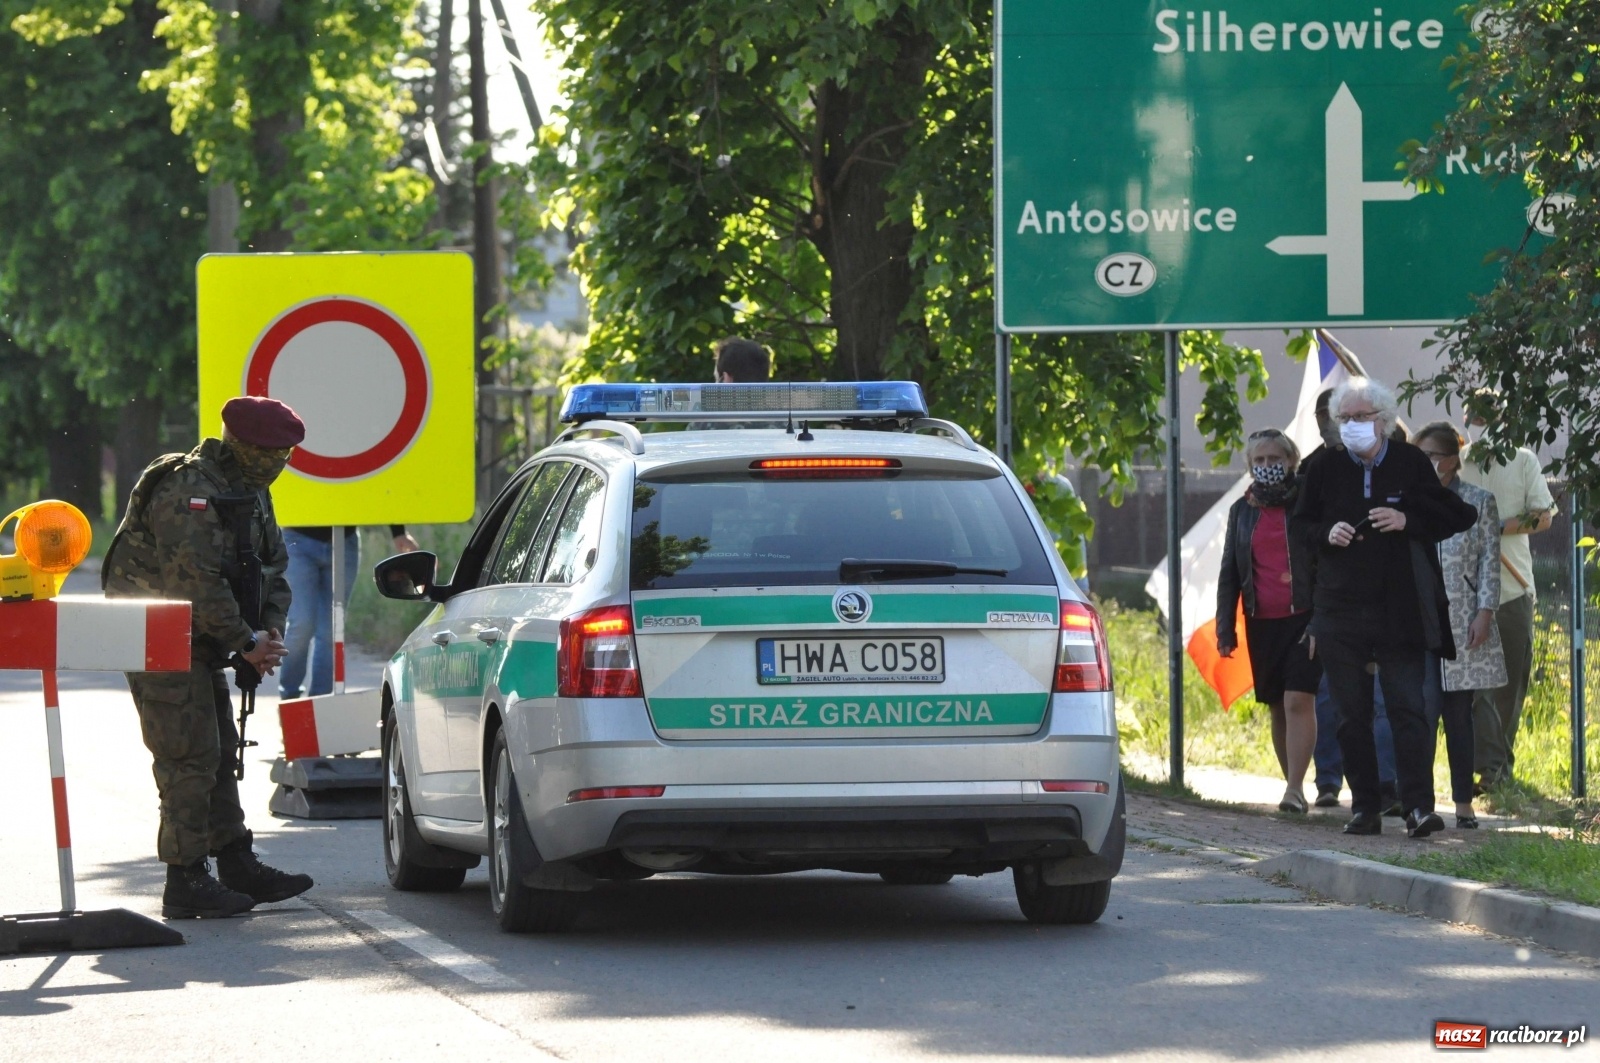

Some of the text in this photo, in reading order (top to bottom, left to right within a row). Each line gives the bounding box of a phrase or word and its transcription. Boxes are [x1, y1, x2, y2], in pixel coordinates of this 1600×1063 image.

[1153, 9, 1444, 54] Silherowice
[1017, 198, 1237, 235] Antosowice
[1104, 261, 1143, 288] CZ
[989, 612, 1053, 623] OCTAVIA
[762, 663, 774, 672] PL
[780, 642, 937, 674] HWA C058
[709, 700, 993, 726] STRAŻ GRANICZNA
